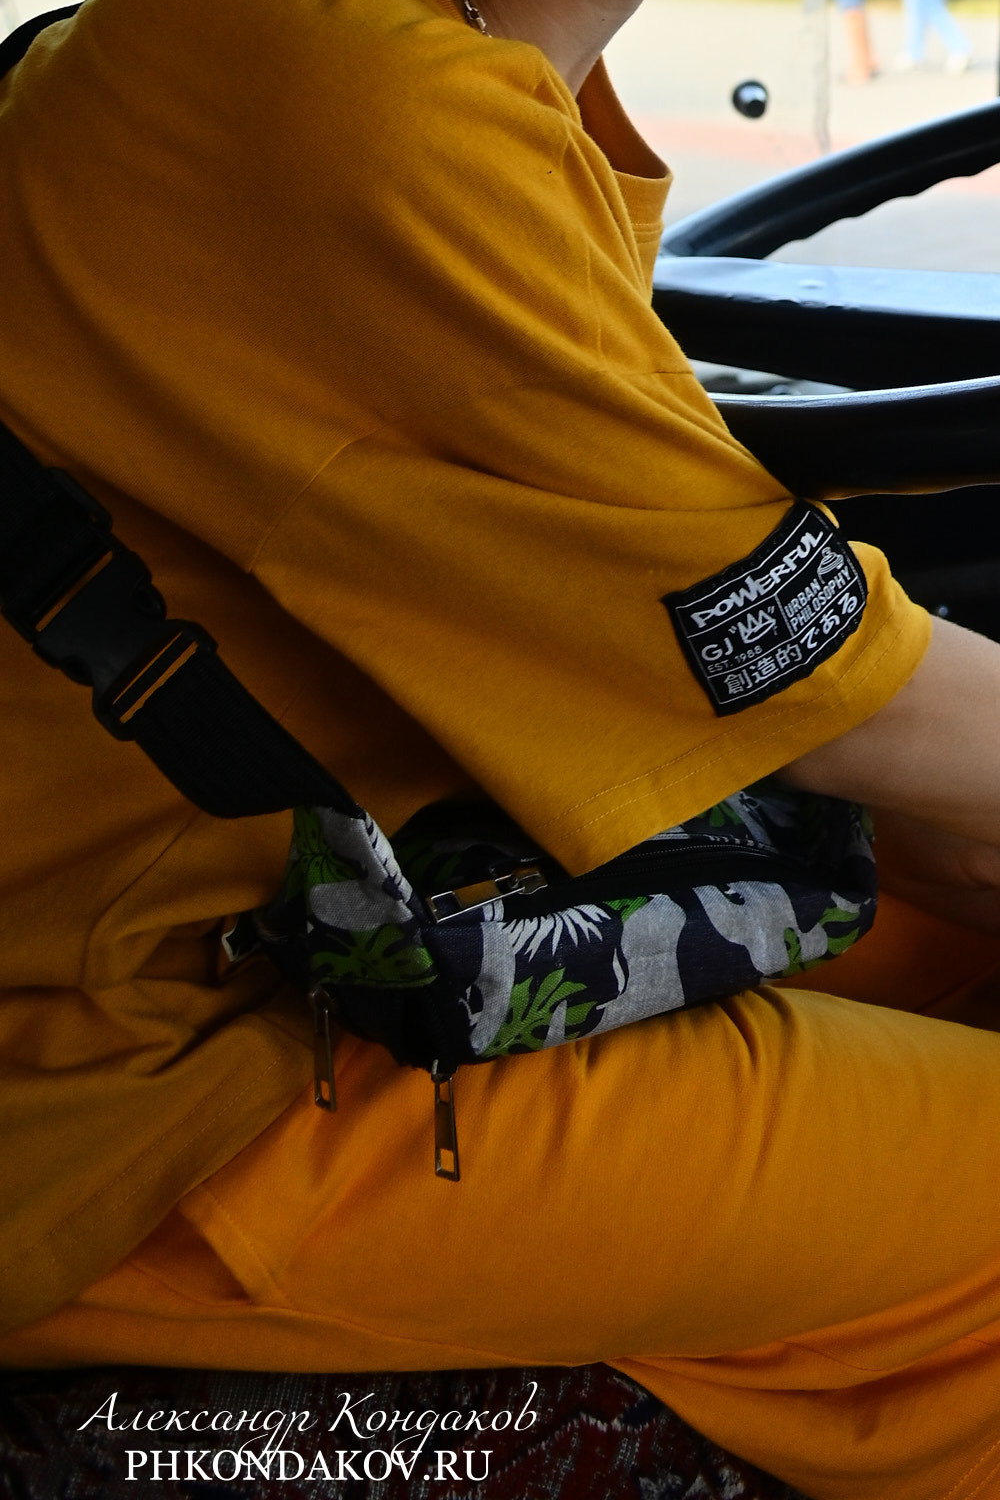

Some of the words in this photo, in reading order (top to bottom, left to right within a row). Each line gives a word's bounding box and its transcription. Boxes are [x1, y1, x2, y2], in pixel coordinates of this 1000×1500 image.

[690, 531, 824, 628] POWERFUL
[784, 578, 821, 617] URBAN
[790, 565, 851, 632] PHILOSOPHY
[707, 660, 734, 673] EST.
[734, 645, 763, 663] 1988
